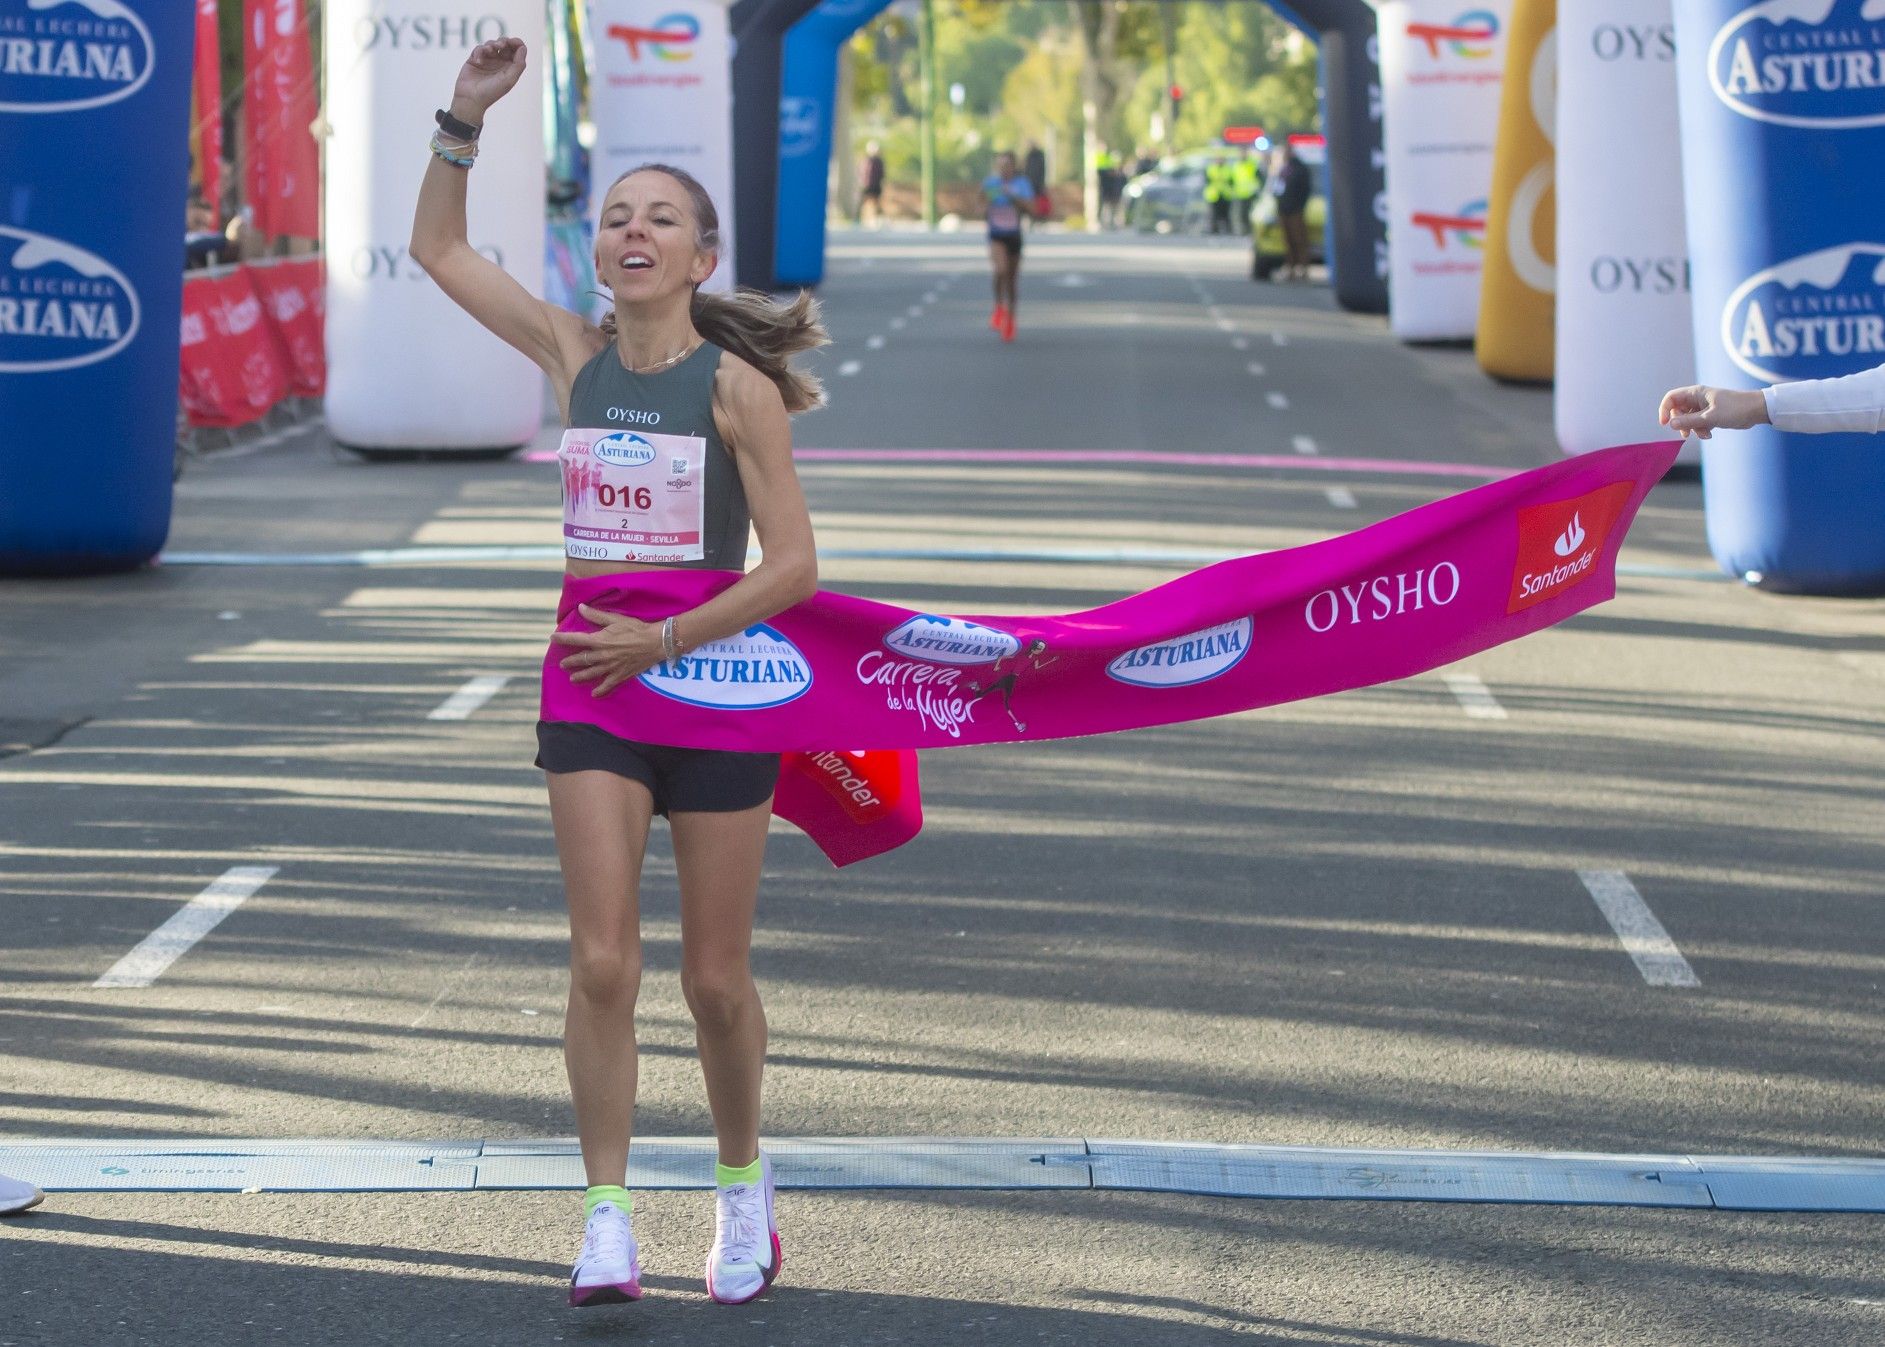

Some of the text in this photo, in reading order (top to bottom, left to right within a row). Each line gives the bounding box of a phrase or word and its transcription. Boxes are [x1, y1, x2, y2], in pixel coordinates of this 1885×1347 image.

[0, 37, 136, 81] RIANA
[1726, 37, 1885, 94] ASTUR
[606, 406, 661, 425] OYSHO
[597, 443, 651, 461] ASTURIANA
[598, 484, 652, 510] 016
[573, 528, 599, 538] CARRERA
[600, 531, 610, 539] DE
[621, 534, 645, 542] MUJER
[650, 535, 680, 543] SEVILLA
[621, 518, 628, 529] 2
[570, 544, 608, 559] OYSHO
[637, 553, 685, 562] Santander
[1519, 547, 1596, 598] Santander
[1305, 561, 1460, 632] OYSHO
[891, 629, 1007, 657] ASTURIANA
[922, 629, 963, 640] CENTRAL
[699, 643, 744, 653] NTRAL
[1113, 629, 1242, 670] ASTURIANA
[857, 650, 962, 686] Carrera
[888, 685, 983, 738] de la Mujer
